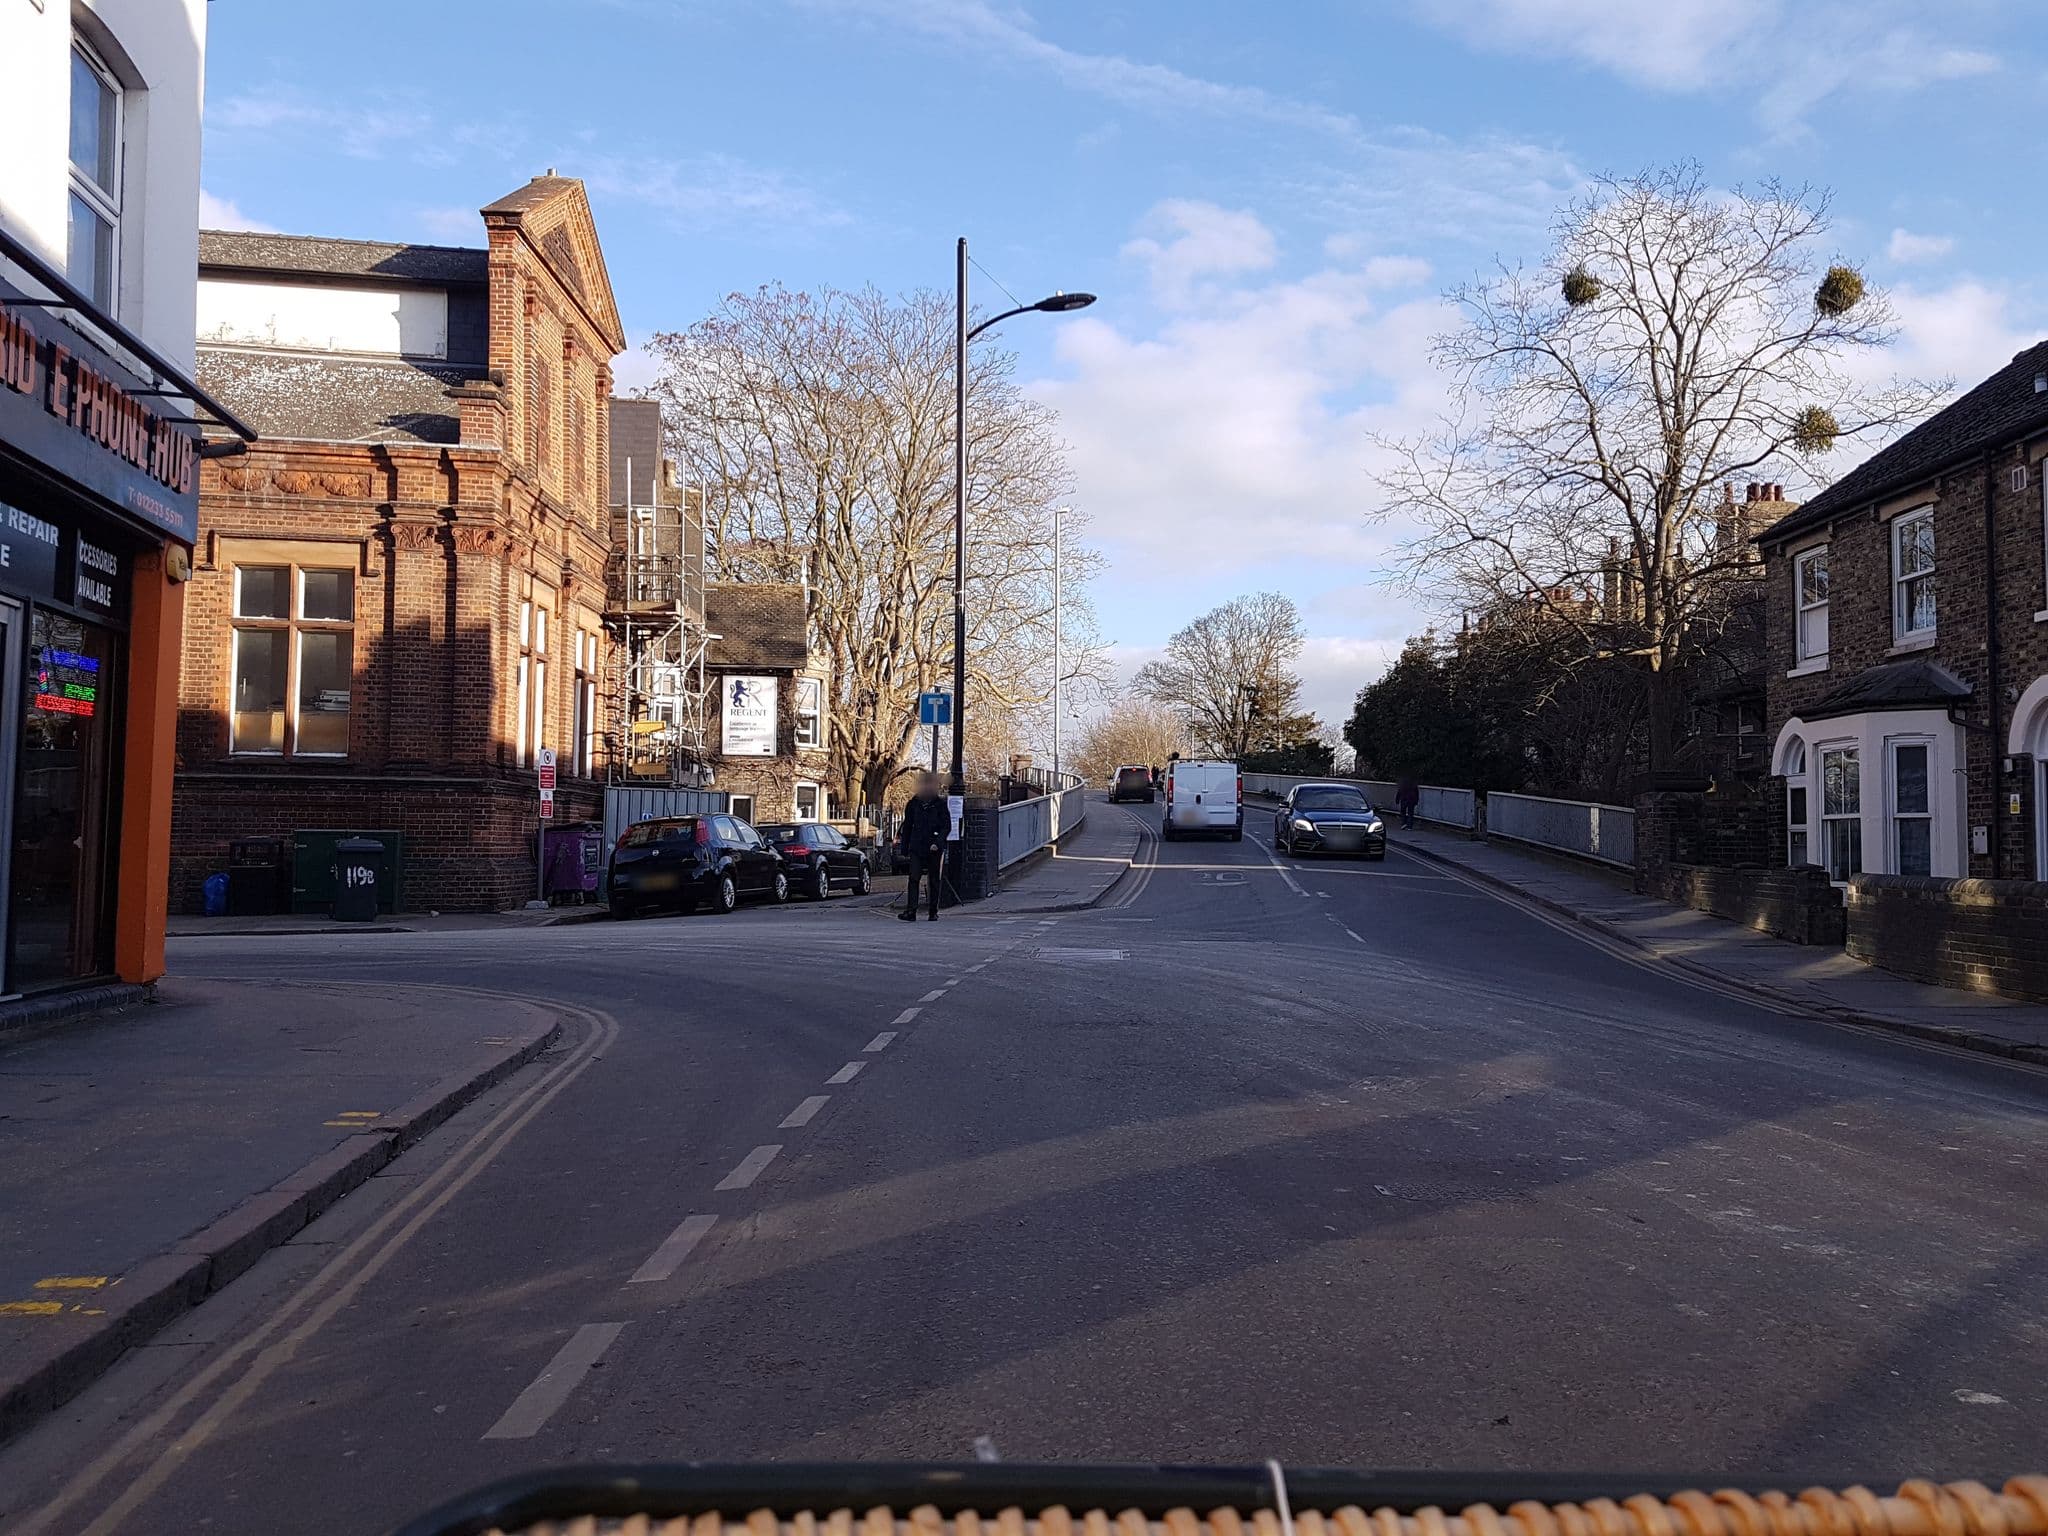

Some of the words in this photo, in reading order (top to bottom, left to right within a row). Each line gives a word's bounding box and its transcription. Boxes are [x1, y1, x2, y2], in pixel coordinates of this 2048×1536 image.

[75, 357, 151, 470] PHONE
[154, 414, 192, 494] HUB
[8, 506, 59, 547] REPAIR
[79, 538, 117, 577] CCESSORIES
[77, 575, 112, 608] AVAILABLE
[730, 708, 767, 717] REGENT
